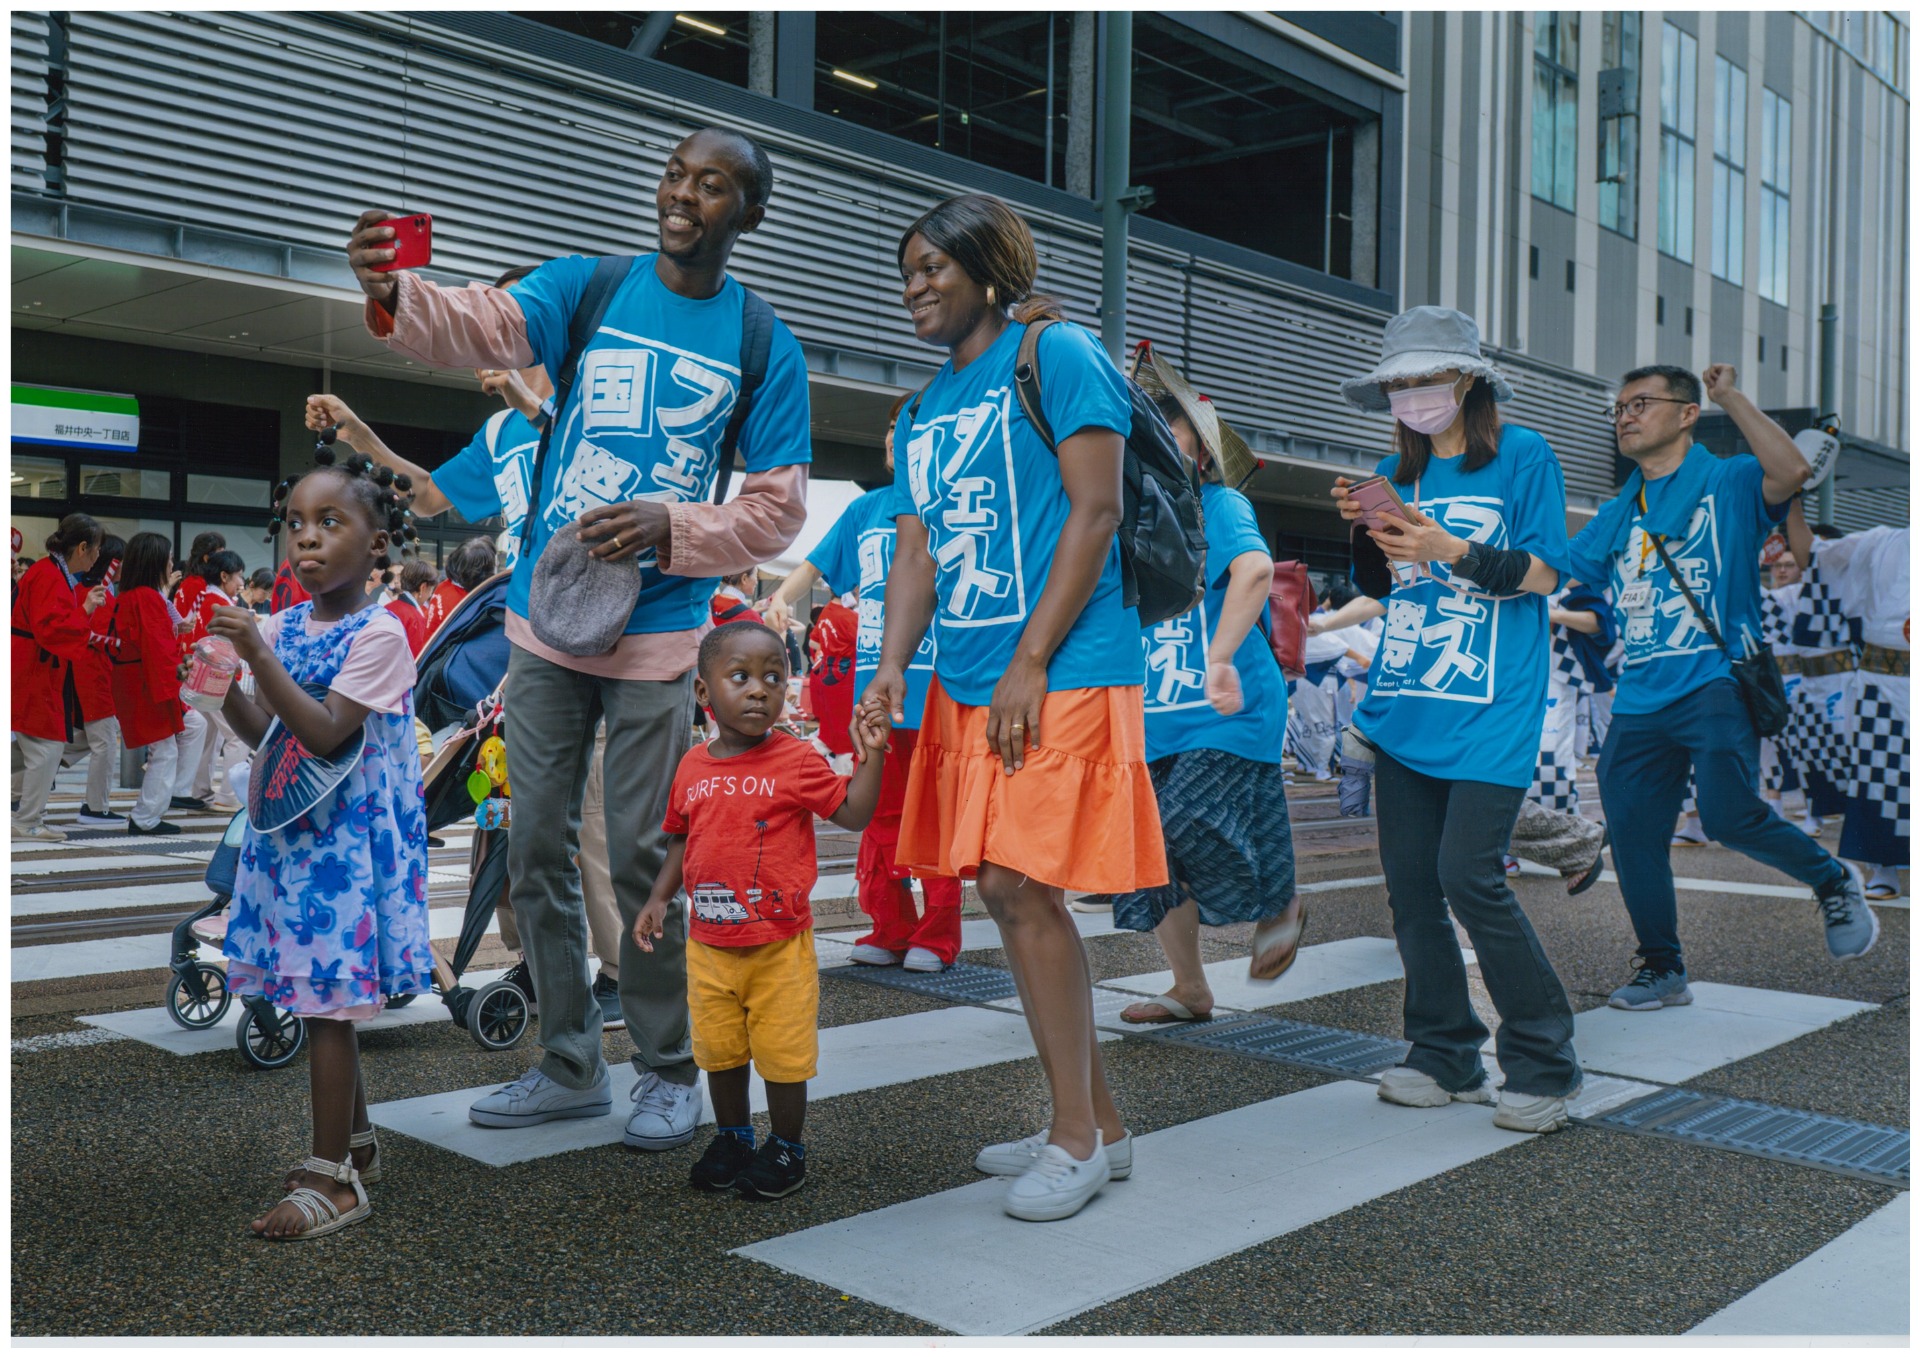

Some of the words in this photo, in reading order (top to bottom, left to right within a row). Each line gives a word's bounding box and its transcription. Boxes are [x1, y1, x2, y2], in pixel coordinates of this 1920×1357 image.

[55, 424, 130, 441] 福井中央一丁目店
[630, 356, 738, 504] フェ
[1621, 592, 1638, 604] FIA
[685, 776, 737, 806] SURF'S
[742, 776, 775, 798] ON
